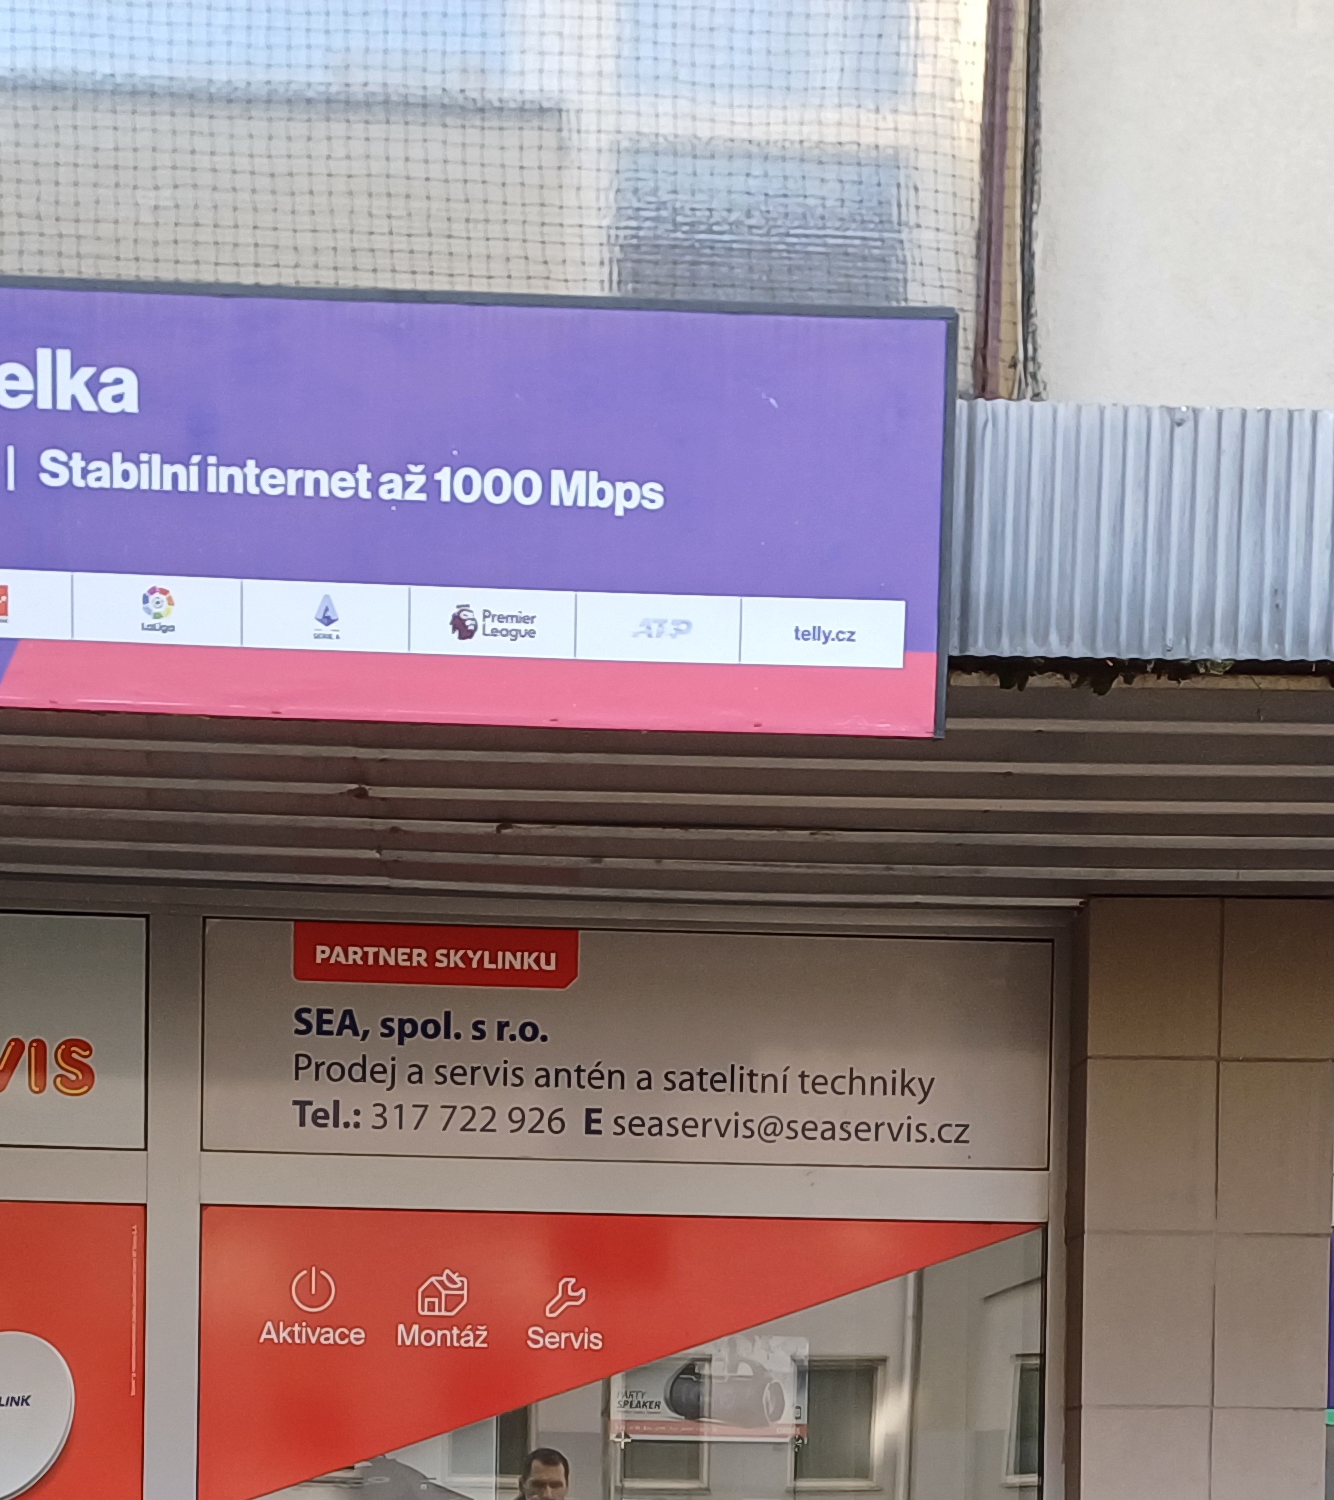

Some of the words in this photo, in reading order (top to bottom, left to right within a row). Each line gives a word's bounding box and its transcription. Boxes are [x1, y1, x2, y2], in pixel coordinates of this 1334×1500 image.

[38, 447, 201, 497] Stabilní
[206, 455, 372, 503] internet
[378, 457, 427, 503] až
[436, 465, 543, 508] 1000
[550, 469, 665, 516] Mbps
[482, 609, 537, 625] Premier
[482, 624, 537, 642] League
[794, 624, 857, 645] telly.cz
[314, 945, 429, 969] PARTNER
[434, 948, 557, 972] SKYLINKU
[292, 1006, 371, 1044] SEA,
[378, 1009, 463, 1046] spol.
[470, 1017, 488, 1041] s
[494, 1017, 550, 1044] r.o.
[292, 1052, 398, 1095] Prodej
[405, 1062, 425, 1086] a
[433, 1056, 525, 1089] servis
[534, 1055, 627, 1092] antén
[634, 1066, 654, 1092] a
[662, 1060, 791, 1096] satelitní
[797, 1064, 936, 1106] techniky
[291, 1098, 363, 1132] Tel.:
[370, 1103, 430, 1133] 317
[439, 1104, 499, 1135] 722
[507, 1105, 567, 1137] 926
[583, 1106, 604, 1137] E
[611, 1109, 971, 1147] seaservis@seaservis.cz
[259, 1319, 366, 1347] Aktivace
[396, 1321, 489, 1350] Montáž
[526, 1324, 605, 1353] Servis
